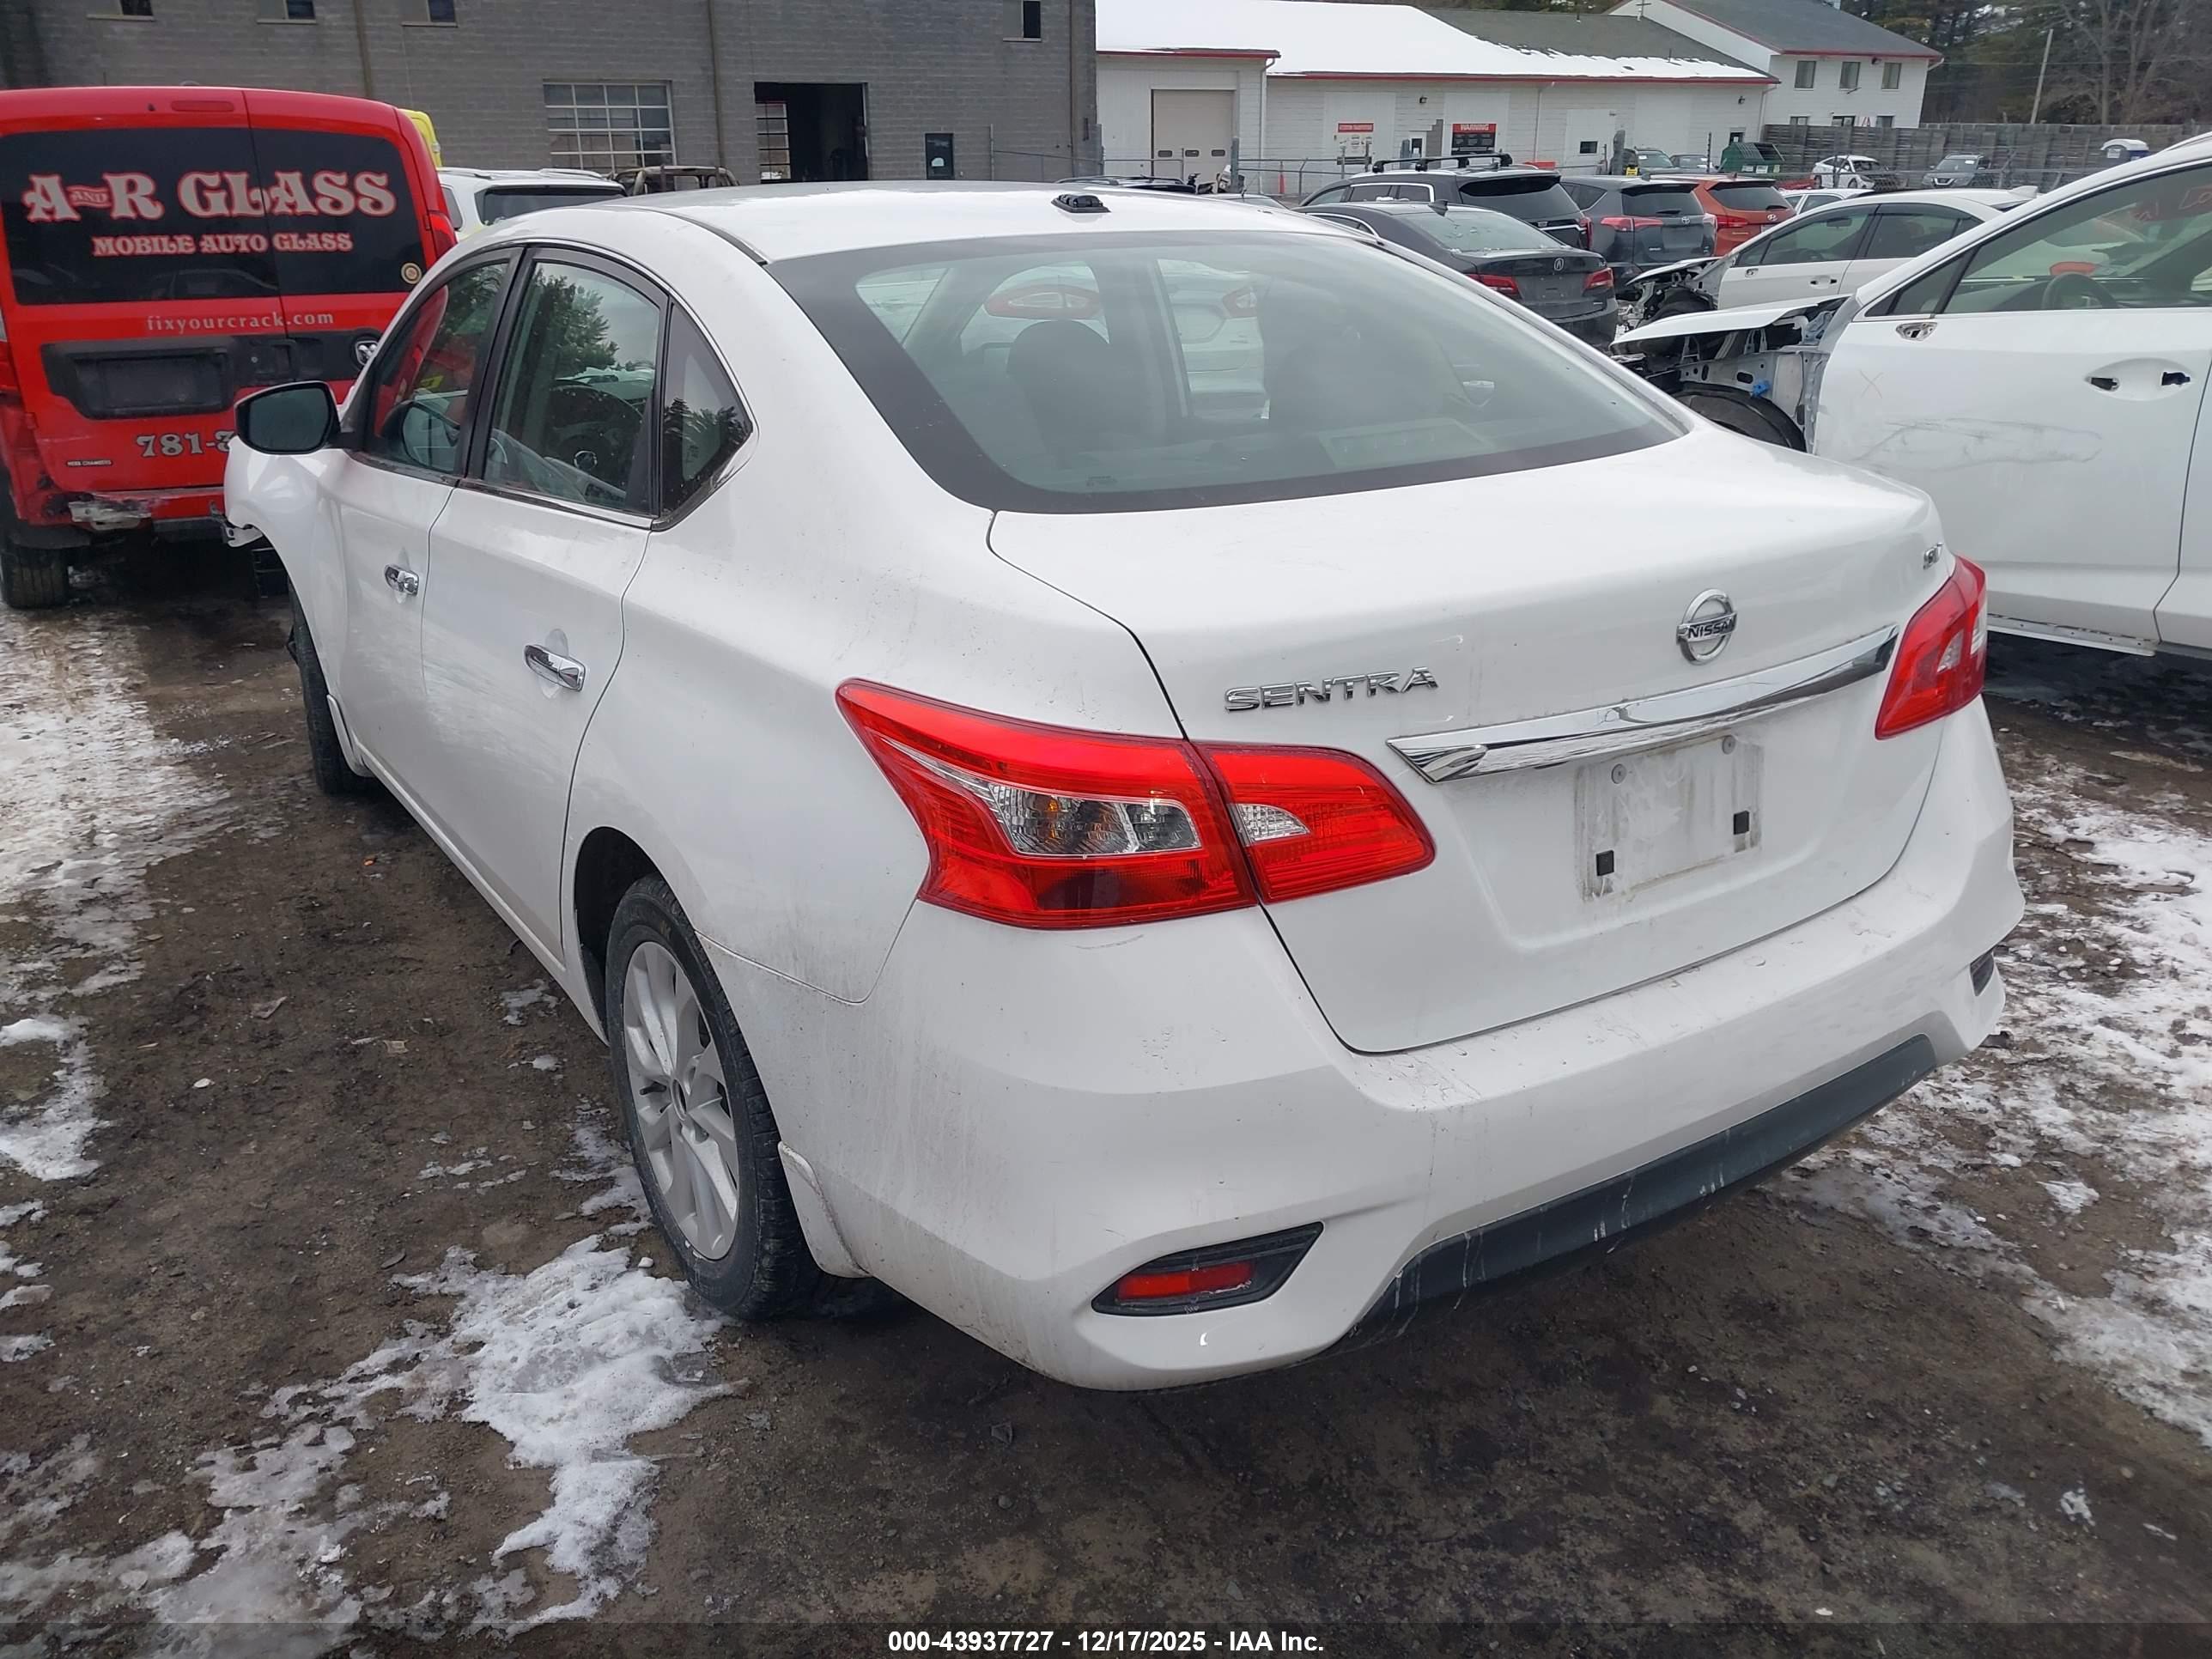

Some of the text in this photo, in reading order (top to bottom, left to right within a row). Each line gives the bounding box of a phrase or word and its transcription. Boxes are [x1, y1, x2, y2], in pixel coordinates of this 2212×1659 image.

[177, 171, 398, 217] GLASS
[93, 232, 353, 257] MOBILE AUTO GLASS
[147, 311, 334, 335] fixyourcrack.com
[1687, 617, 1734, 640] NISSAN
[1224, 666, 1439, 714] SENTRA
